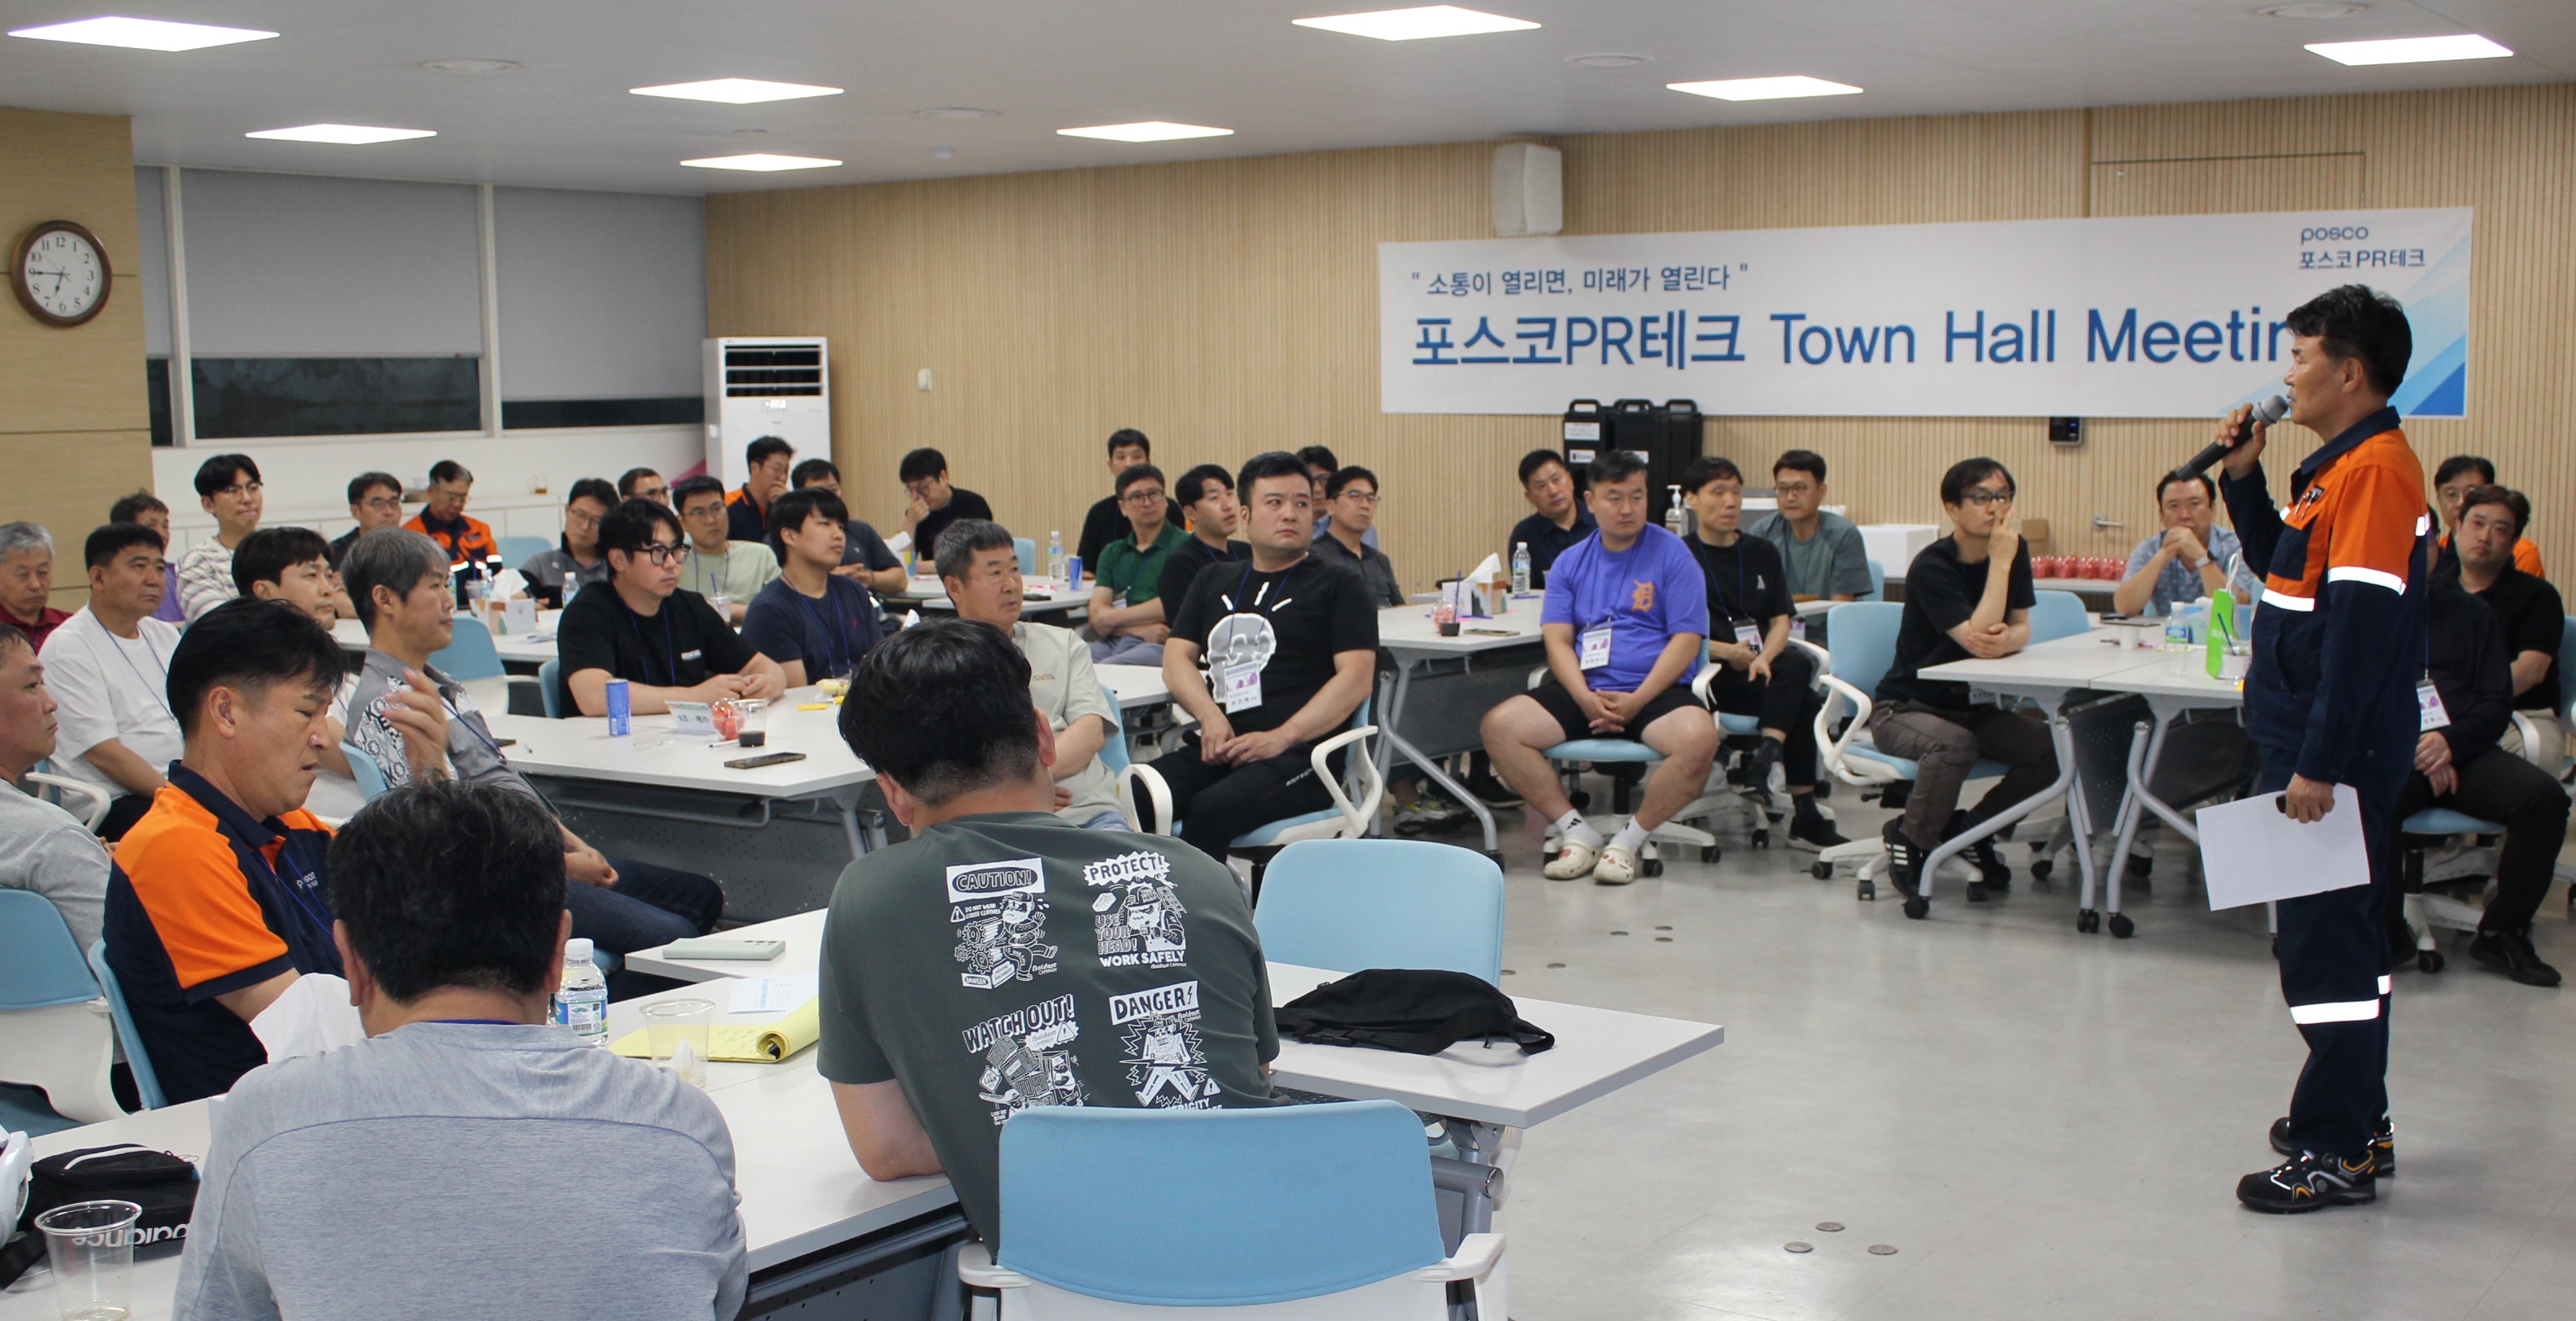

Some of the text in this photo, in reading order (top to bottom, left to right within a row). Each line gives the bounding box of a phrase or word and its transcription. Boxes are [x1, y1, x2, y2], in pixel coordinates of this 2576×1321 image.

[56, 237, 66, 247] 12
[2300, 226, 2369, 245] posco
[41, 240, 50, 252] 11
[72, 241, 77, 252] 1
[30, 252, 41, 262] 10
[84, 254, 90, 264] 2
[2299, 248, 2425, 269] 포스코PR테크
[87, 270, 94, 281] 3
[1426, 269, 1492, 297] 소통이
[1501, 268, 1574, 296] 열리면,
[1583, 265, 1651, 294] 미래가
[1661, 264, 1730, 291] 열린다
[33, 283, 40, 294] 8
[84, 286, 90, 296] 4
[44, 296, 50, 308] 7
[59, 301, 66, 312] 6
[74, 298, 81, 308] 5
[1412, 305, 2288, 370] 포스코PR테크 Town Hall Meetin
[1089, 856, 1164, 880] PROTECT!
[955, 870, 1033, 891] CAUTION!
[1094, 914, 1120, 928] USE
[1094, 925, 1130, 941] YOUR
[1097, 938, 1137, 955] HEAD!
[1099, 951, 1185, 967] WORK SAFELY
[966, 977, 987, 985] DANGER
[962, 993, 1076, 1054] WATCH OUT!
[1032, 1029, 1057, 1043] Boldest
